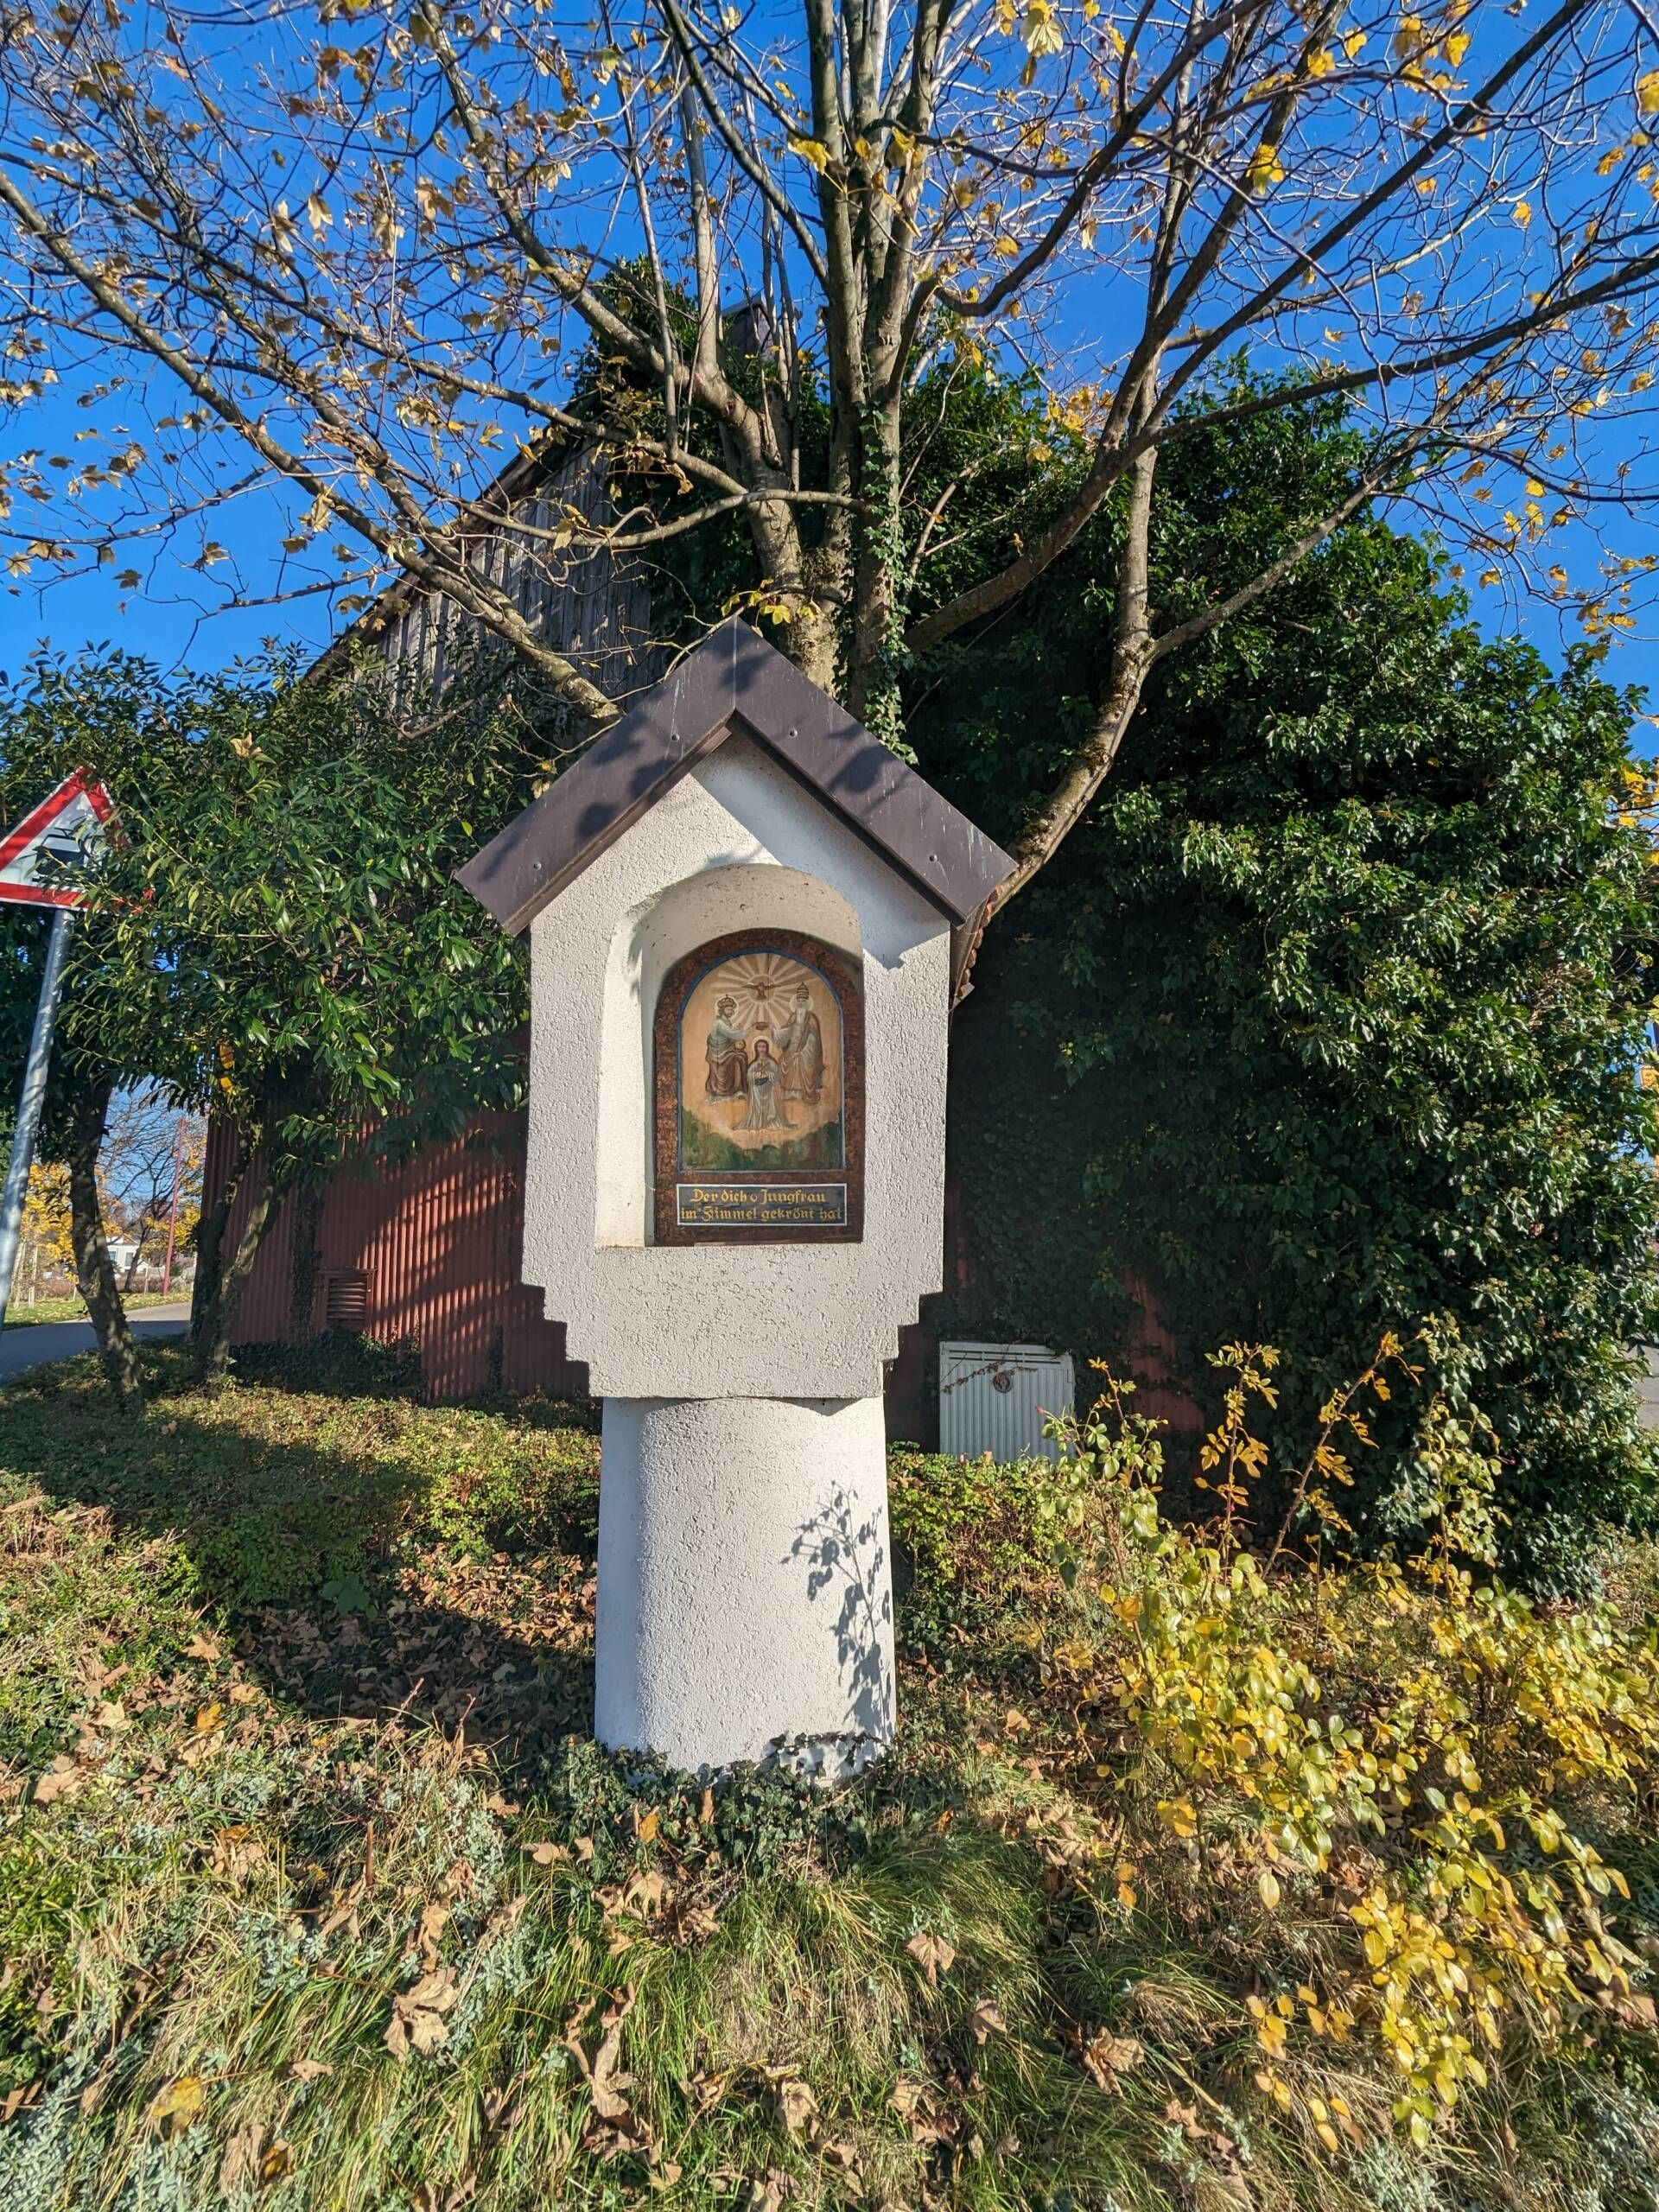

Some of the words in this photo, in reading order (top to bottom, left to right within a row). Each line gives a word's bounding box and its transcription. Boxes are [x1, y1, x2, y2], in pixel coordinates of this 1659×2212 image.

[690, 1188, 718, 1203] Der
[721, 1188, 747, 1203] dich
[760, 1188, 826, 1205] Jungfrau
[681, 1208, 697, 1219] im
[819, 1206, 842, 1222] hat
